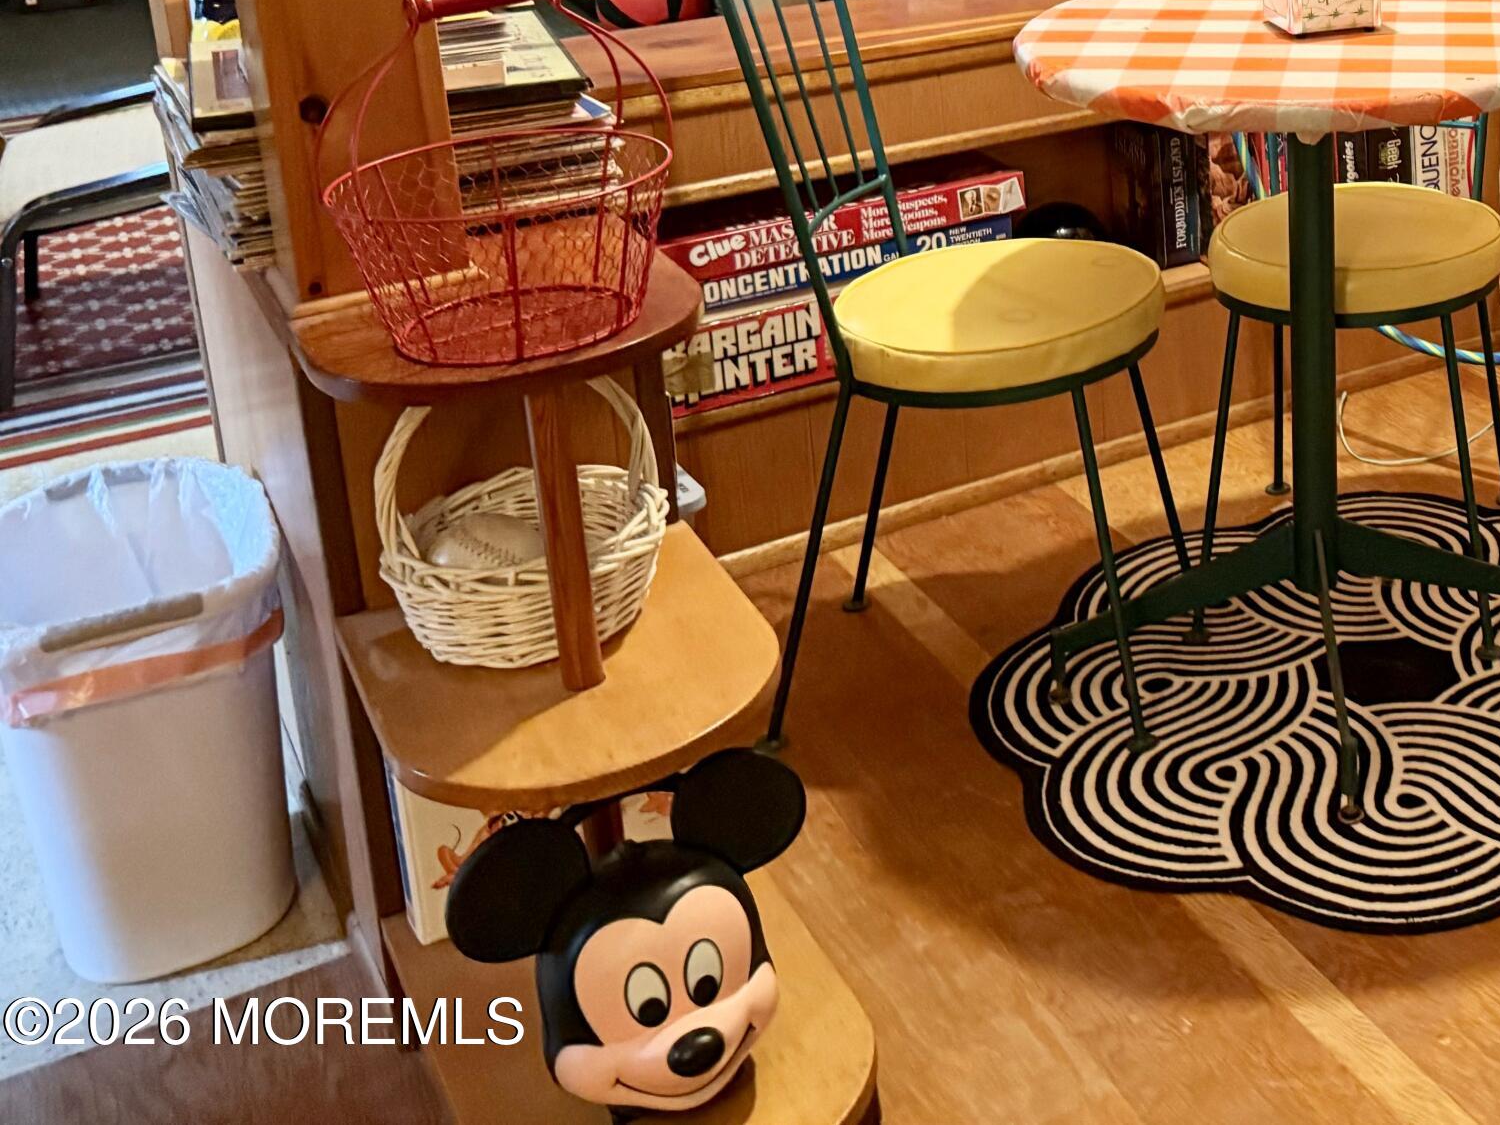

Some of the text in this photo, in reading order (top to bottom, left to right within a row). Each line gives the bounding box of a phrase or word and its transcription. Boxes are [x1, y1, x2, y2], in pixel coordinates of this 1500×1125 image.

[1169, 136, 1188, 250] FORBIDDEN ISLAND
[688, 213, 838, 268] Clue MASR
[916, 231, 947, 255] 20
[949, 226, 967, 236] NEW
[950, 227, 993, 243] TWENTIETH
[703, 244, 884, 305] ONCENTRATION
